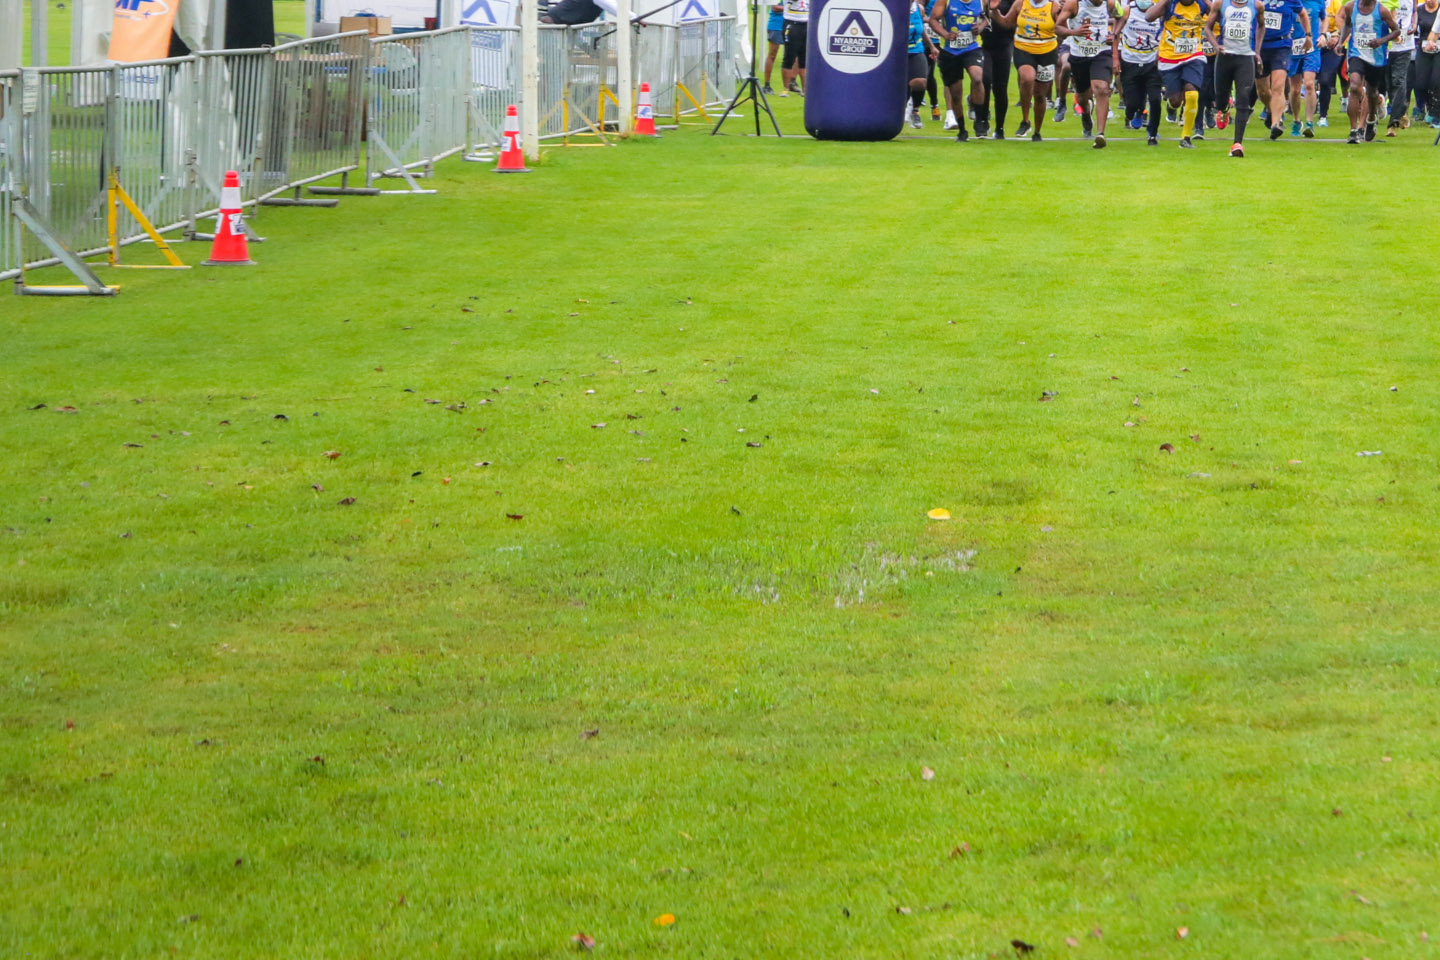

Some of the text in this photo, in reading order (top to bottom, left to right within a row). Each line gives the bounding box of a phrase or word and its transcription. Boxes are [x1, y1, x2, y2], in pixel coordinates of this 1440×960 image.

[1229, 28, 1246, 37] 8016
[834, 37, 874, 46] NYARADZO
[840, 45, 867, 53] GROUP
[1179, 44, 1194, 52] 7912
